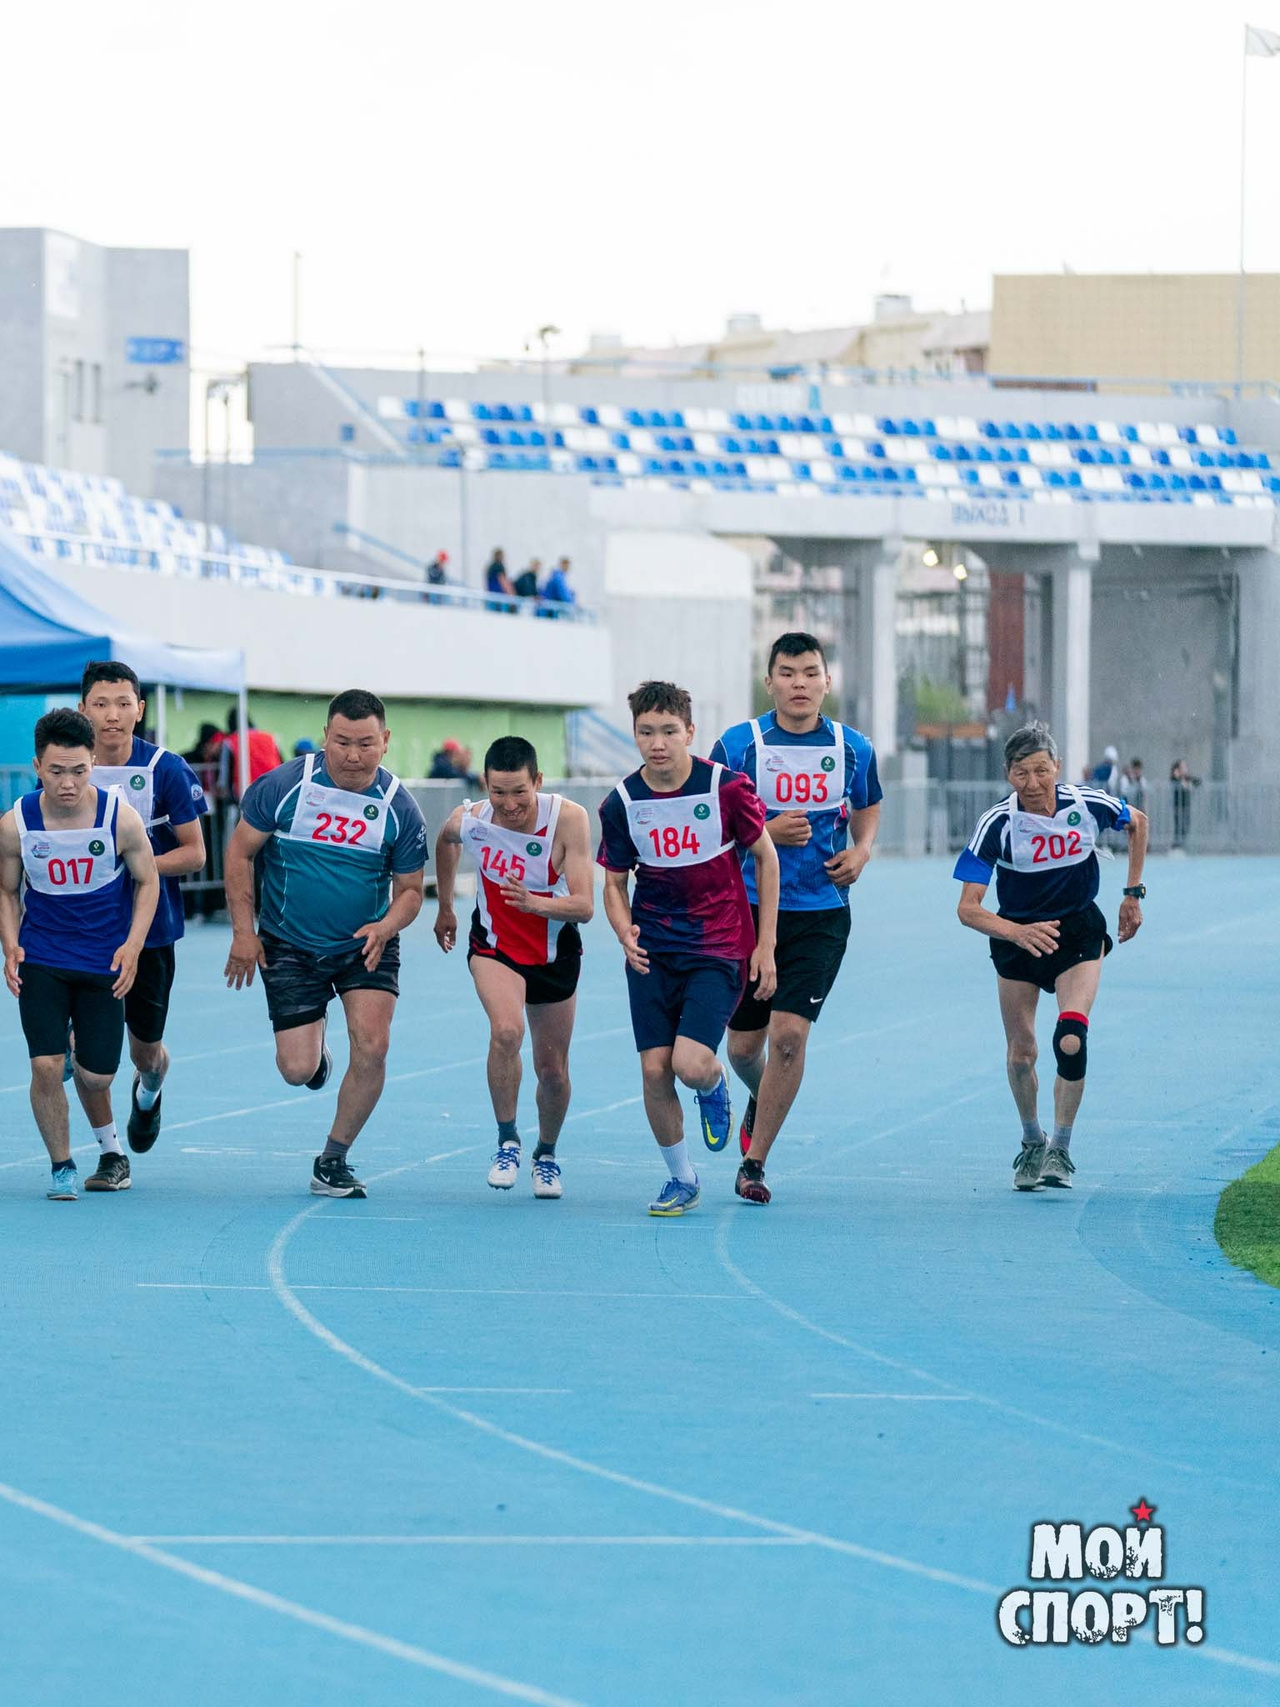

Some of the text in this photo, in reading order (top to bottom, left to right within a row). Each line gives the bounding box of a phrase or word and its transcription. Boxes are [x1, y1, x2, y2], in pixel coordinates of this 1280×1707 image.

[776, 773, 828, 803] 093
[312, 813, 367, 845] 232
[649, 826, 700, 858] 184
[1031, 831, 1082, 863] 202
[48, 858, 94, 885] 017
[481, 846, 525, 881] 145
